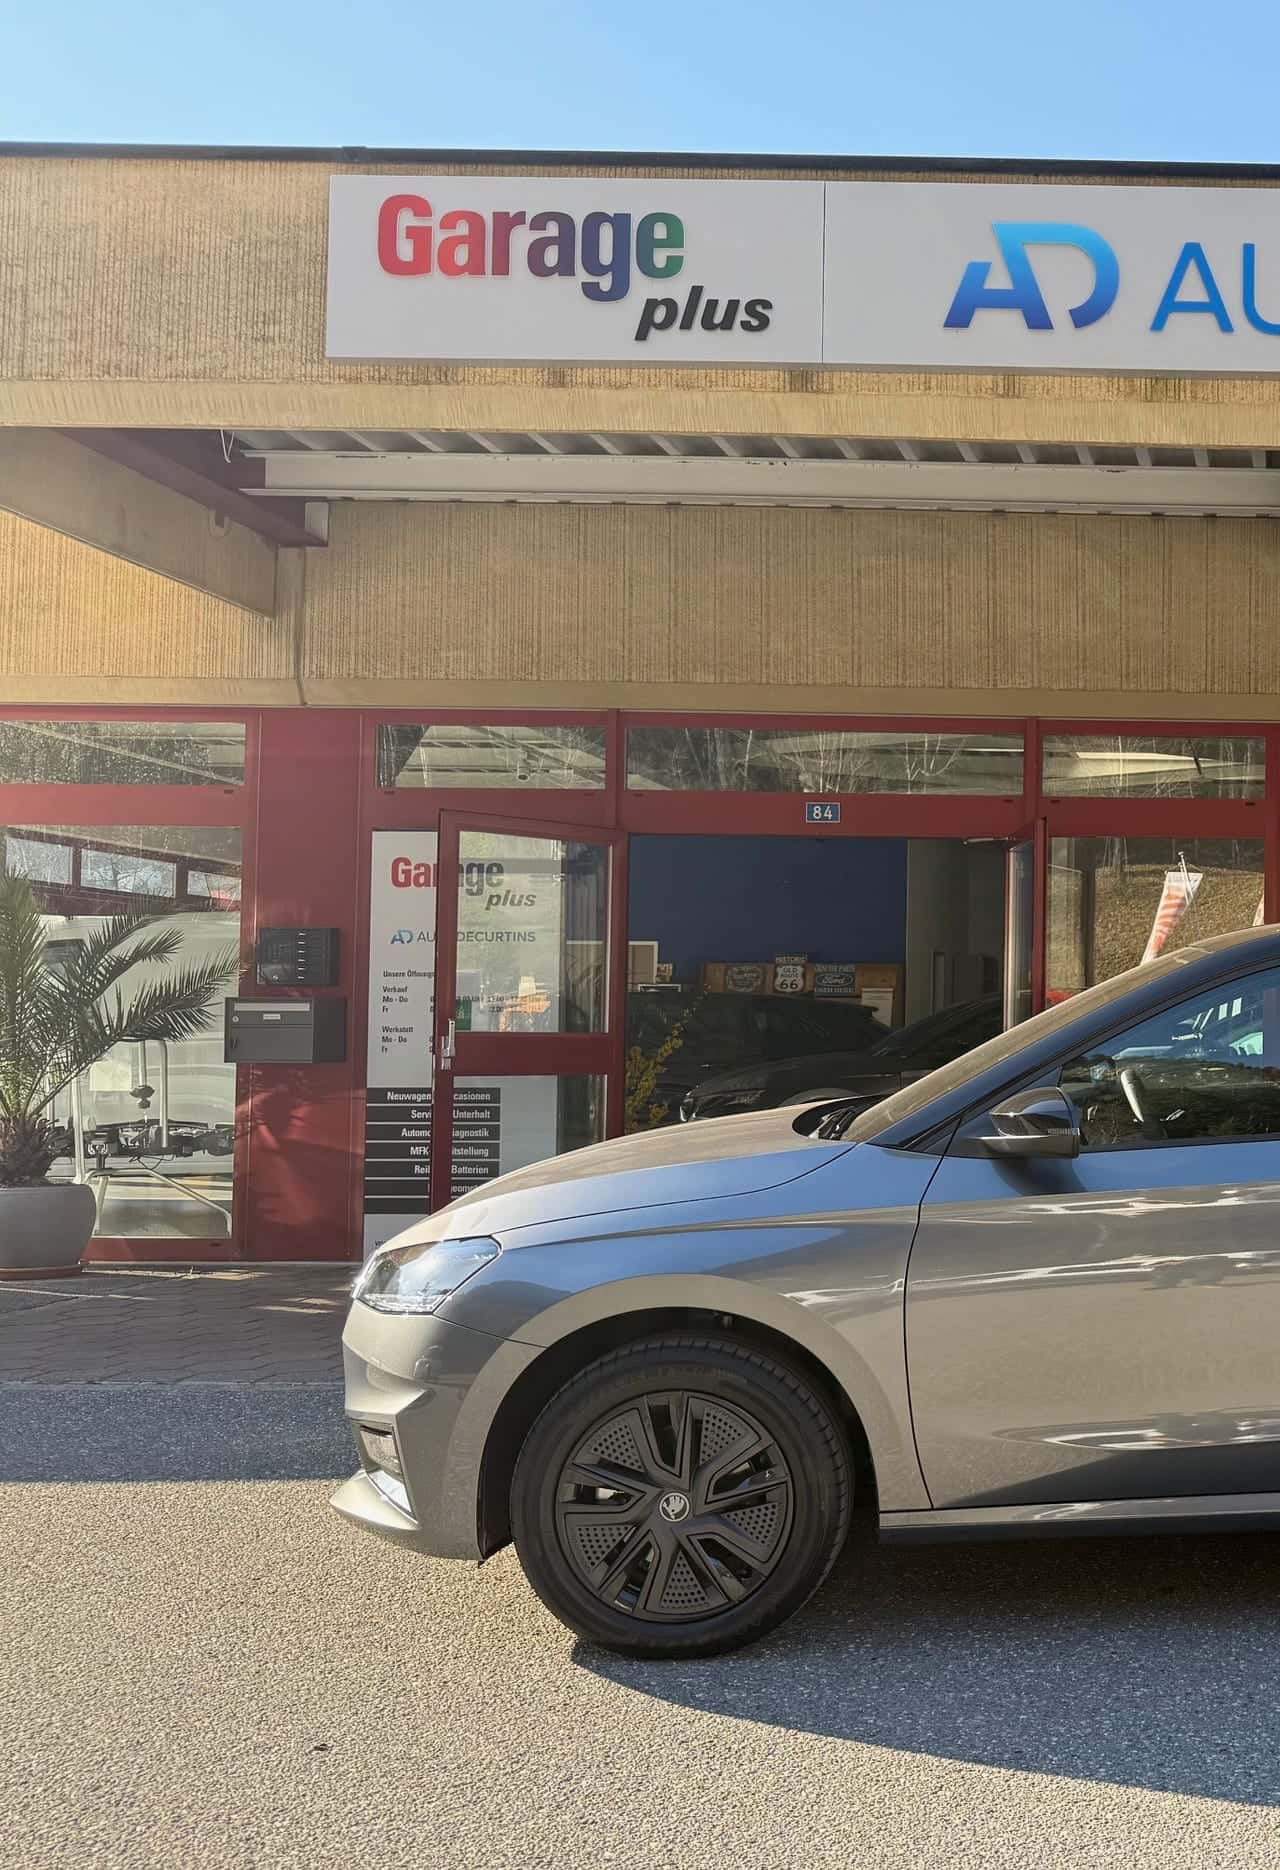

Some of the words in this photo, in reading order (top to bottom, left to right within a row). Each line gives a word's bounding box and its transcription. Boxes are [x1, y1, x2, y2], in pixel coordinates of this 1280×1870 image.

[376, 193, 685, 302] Garage
[633, 285, 773, 342] plus
[813, 805, 833, 820] 84
[391, 856, 504, 896] Gage
[485, 889, 537, 911] plus
[416, 931, 537, 943] AUDECURTINS
[383, 970, 406, 978] Unsere
[779, 978, 799, 990] 66
[382, 995, 394, 1003] Mo
[399, 995, 409, 1003] Do
[381, 1045, 388, 1053] Fr
[387, 1091, 432, 1103] Neuwagen
[411, 1109, 432, 1119] Servi
[452, 1109, 491, 1119] Unterhalt
[451, 1164, 489, 1174] Batterien
